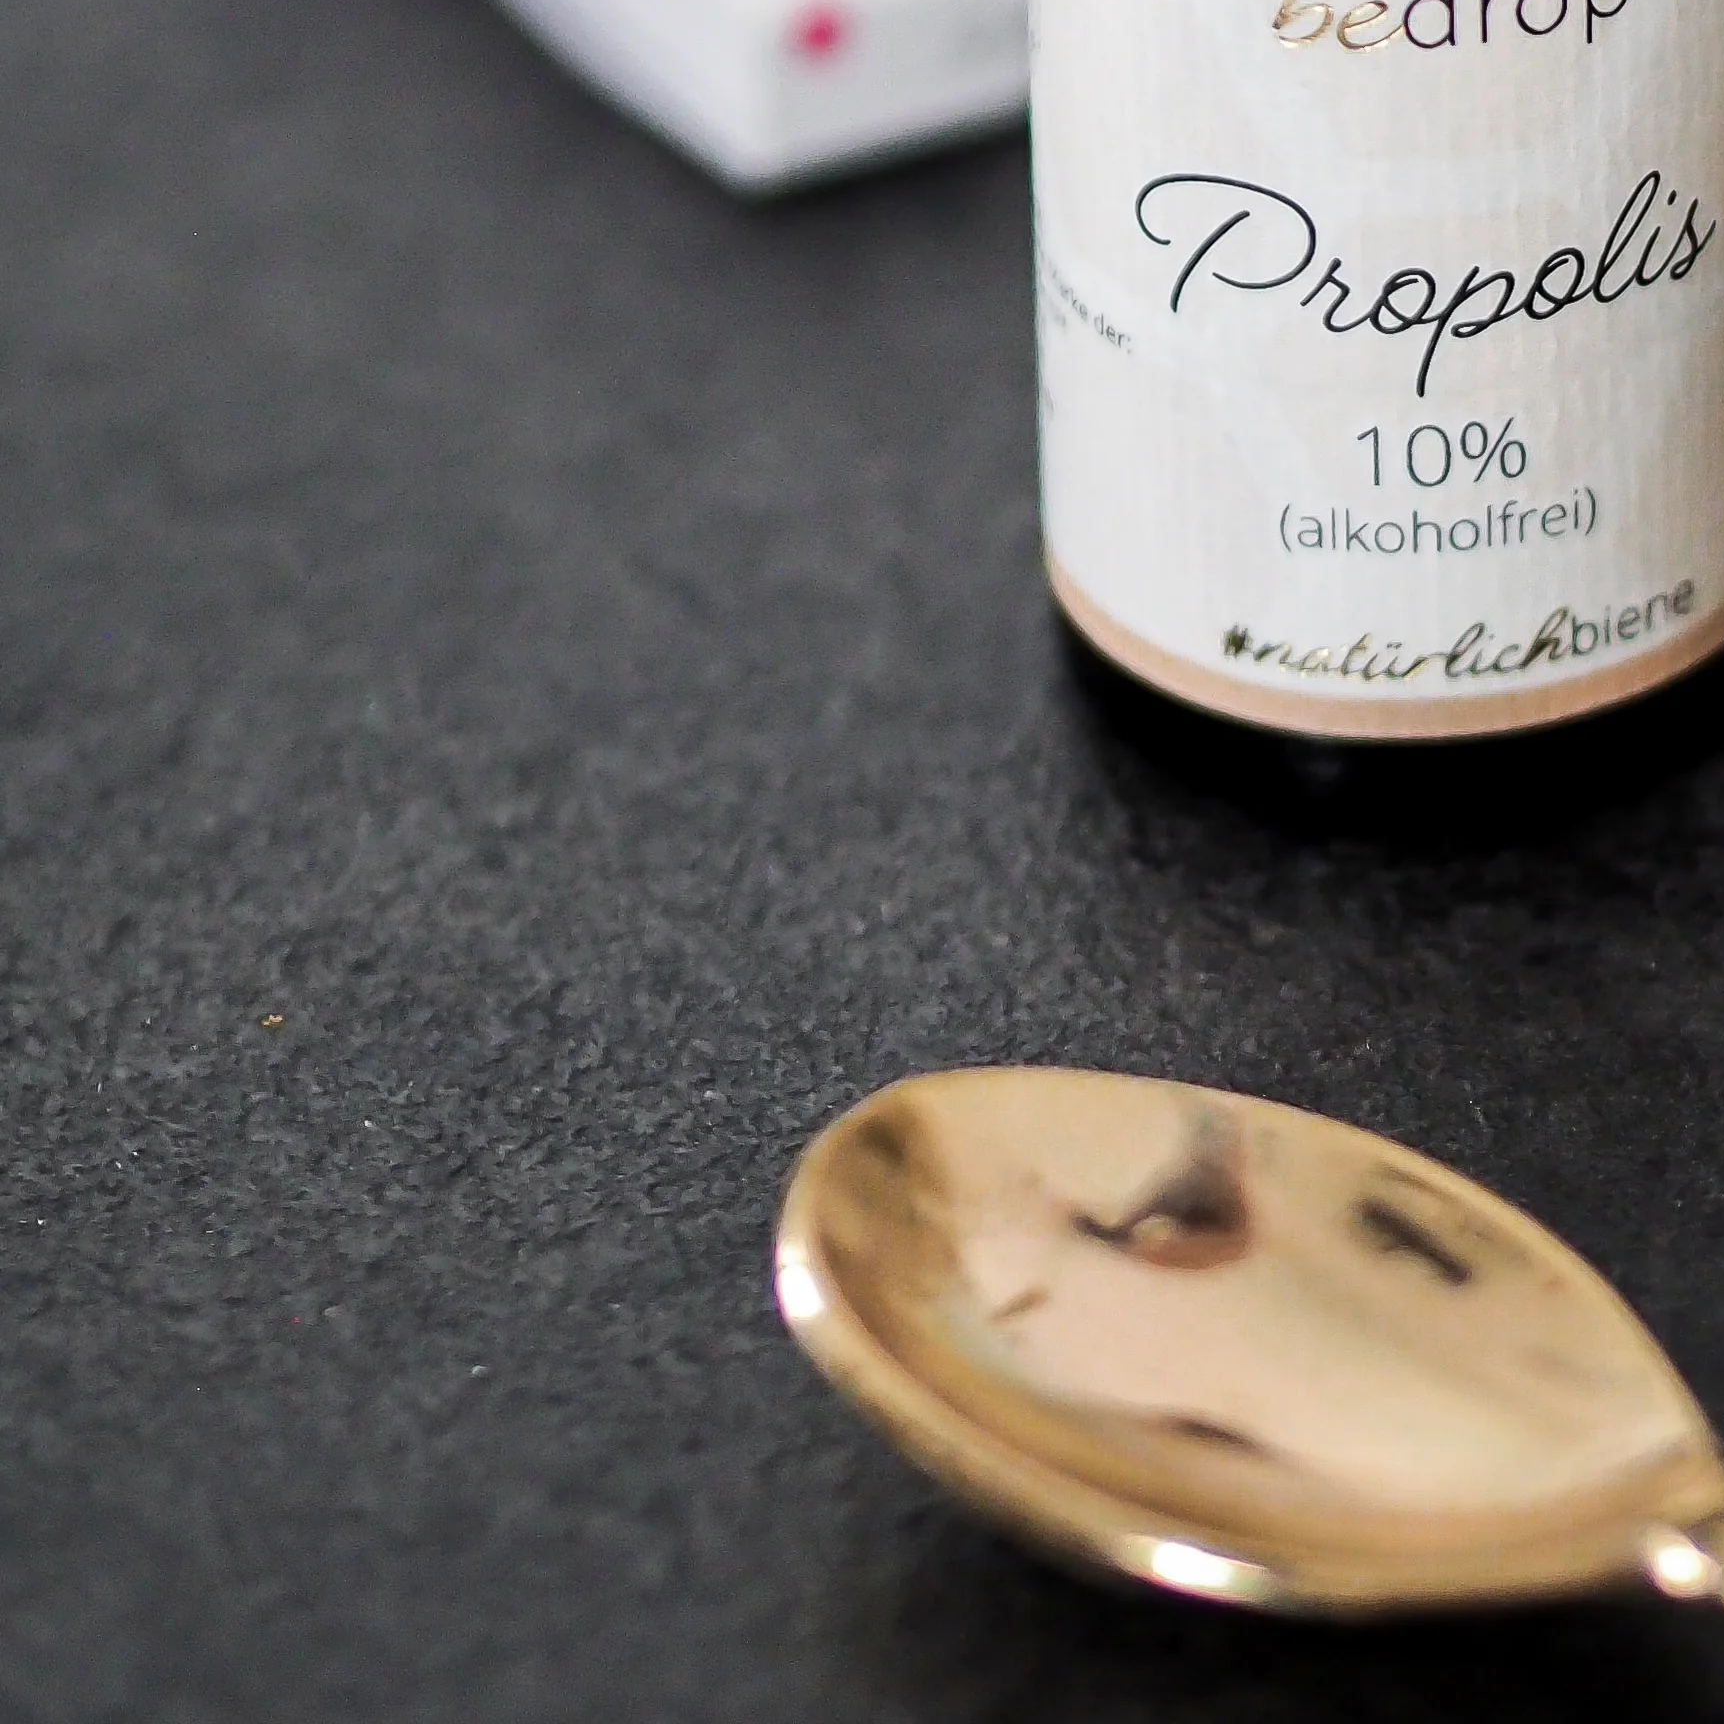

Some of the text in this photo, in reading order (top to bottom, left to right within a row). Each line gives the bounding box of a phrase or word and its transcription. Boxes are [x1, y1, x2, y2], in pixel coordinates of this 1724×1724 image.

[1135, 169, 1717, 398] Propolis
[1356, 416, 1528, 488] 10%
[1279, 486, 1599, 554] (alkoholfrei)
